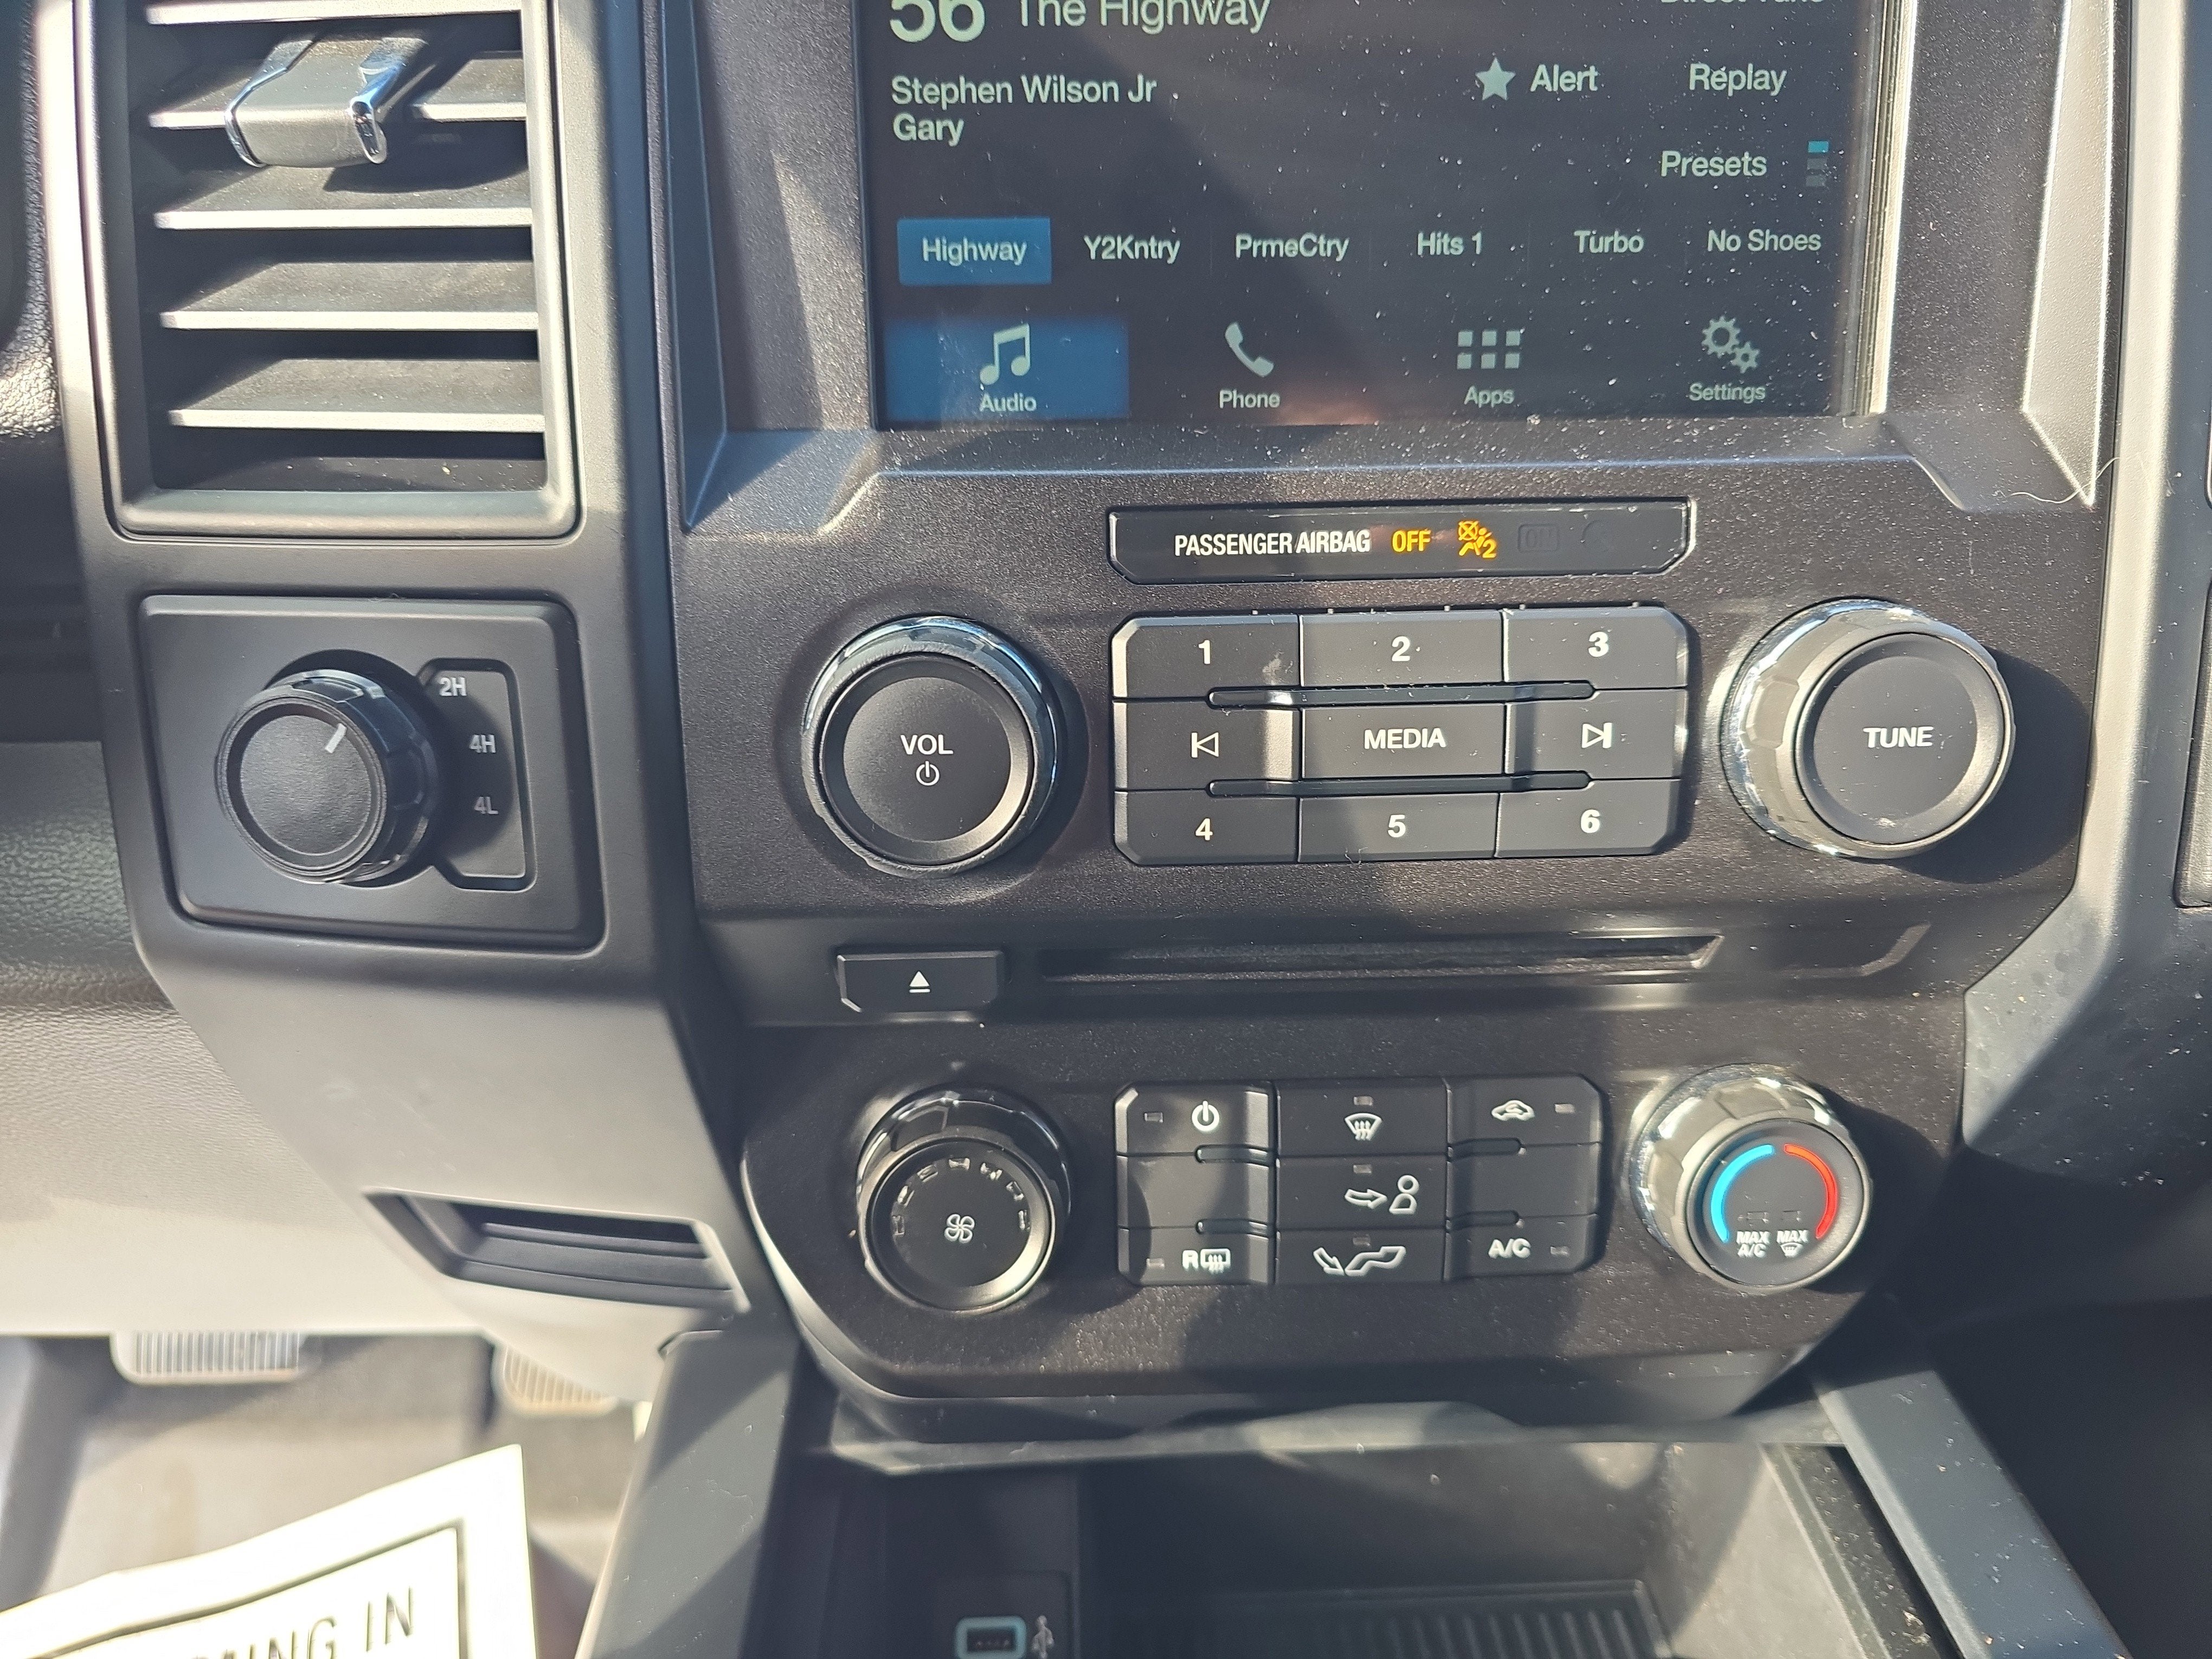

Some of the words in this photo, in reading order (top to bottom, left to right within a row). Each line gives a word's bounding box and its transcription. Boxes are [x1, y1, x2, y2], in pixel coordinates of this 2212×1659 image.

[890, 0, 985, 42] 56
[1020, 0, 1086, 27] The
[1100, 0, 1270, 34] Highway
[1530, 64, 1599, 92] Alert
[1689, 63, 1787, 97] Replay
[892, 75, 1013, 111] Stephen
[1021, 74, 1119, 104] Wilson
[1128, 73, 1158, 103] Jr
[893, 113, 964, 147] Gary
[1661, 150, 1767, 177] Presets
[922, 237, 1027, 266] Highway
[1084, 235, 1181, 264] Y2Kntry
[1236, 233, 1350, 262] PrmeCtry
[1417, 232, 1464, 255] Hits
[1471, 232, 1483, 255] 1
[1573, 230, 1645, 254] Turbo
[1707, 229, 1741, 252] No
[1747, 228, 1822, 252] Shoes
[979, 393, 1037, 413] Audio
[1219, 389, 1281, 409] Phone
[1464, 385, 1515, 408] Apps
[1689, 382, 1766, 403] Settings
[1175, 532, 1293, 556] PASSENGER
[1296, 530, 1372, 554] AIRBAG
[1392, 529, 1431, 552] OFF
[1198, 640, 1211, 664] 1
[1391, 636, 1411, 662] 2
[1588, 632, 1609, 658] 3
[440, 677, 467, 696] 2H
[468, 734, 496, 753] 4H
[900, 734, 954, 755] VOL
[1364, 728, 1446, 749] MEDIA
[1863, 726, 1934, 748] TUNE
[474, 796, 498, 814] 4L
[1195, 818, 1213, 841] 4
[1387, 814, 1406, 838] 5
[1580, 809, 1600, 833] 6
[1488, 1238, 1531, 1258] A/C
[1736, 1231, 1770, 1244] MAX
[1776, 1230, 1809, 1243] MAX
[1182, 1250, 1199, 1270] R
[1738, 1243, 1767, 1258] A/C
[365, 1586, 414, 1652] IN
